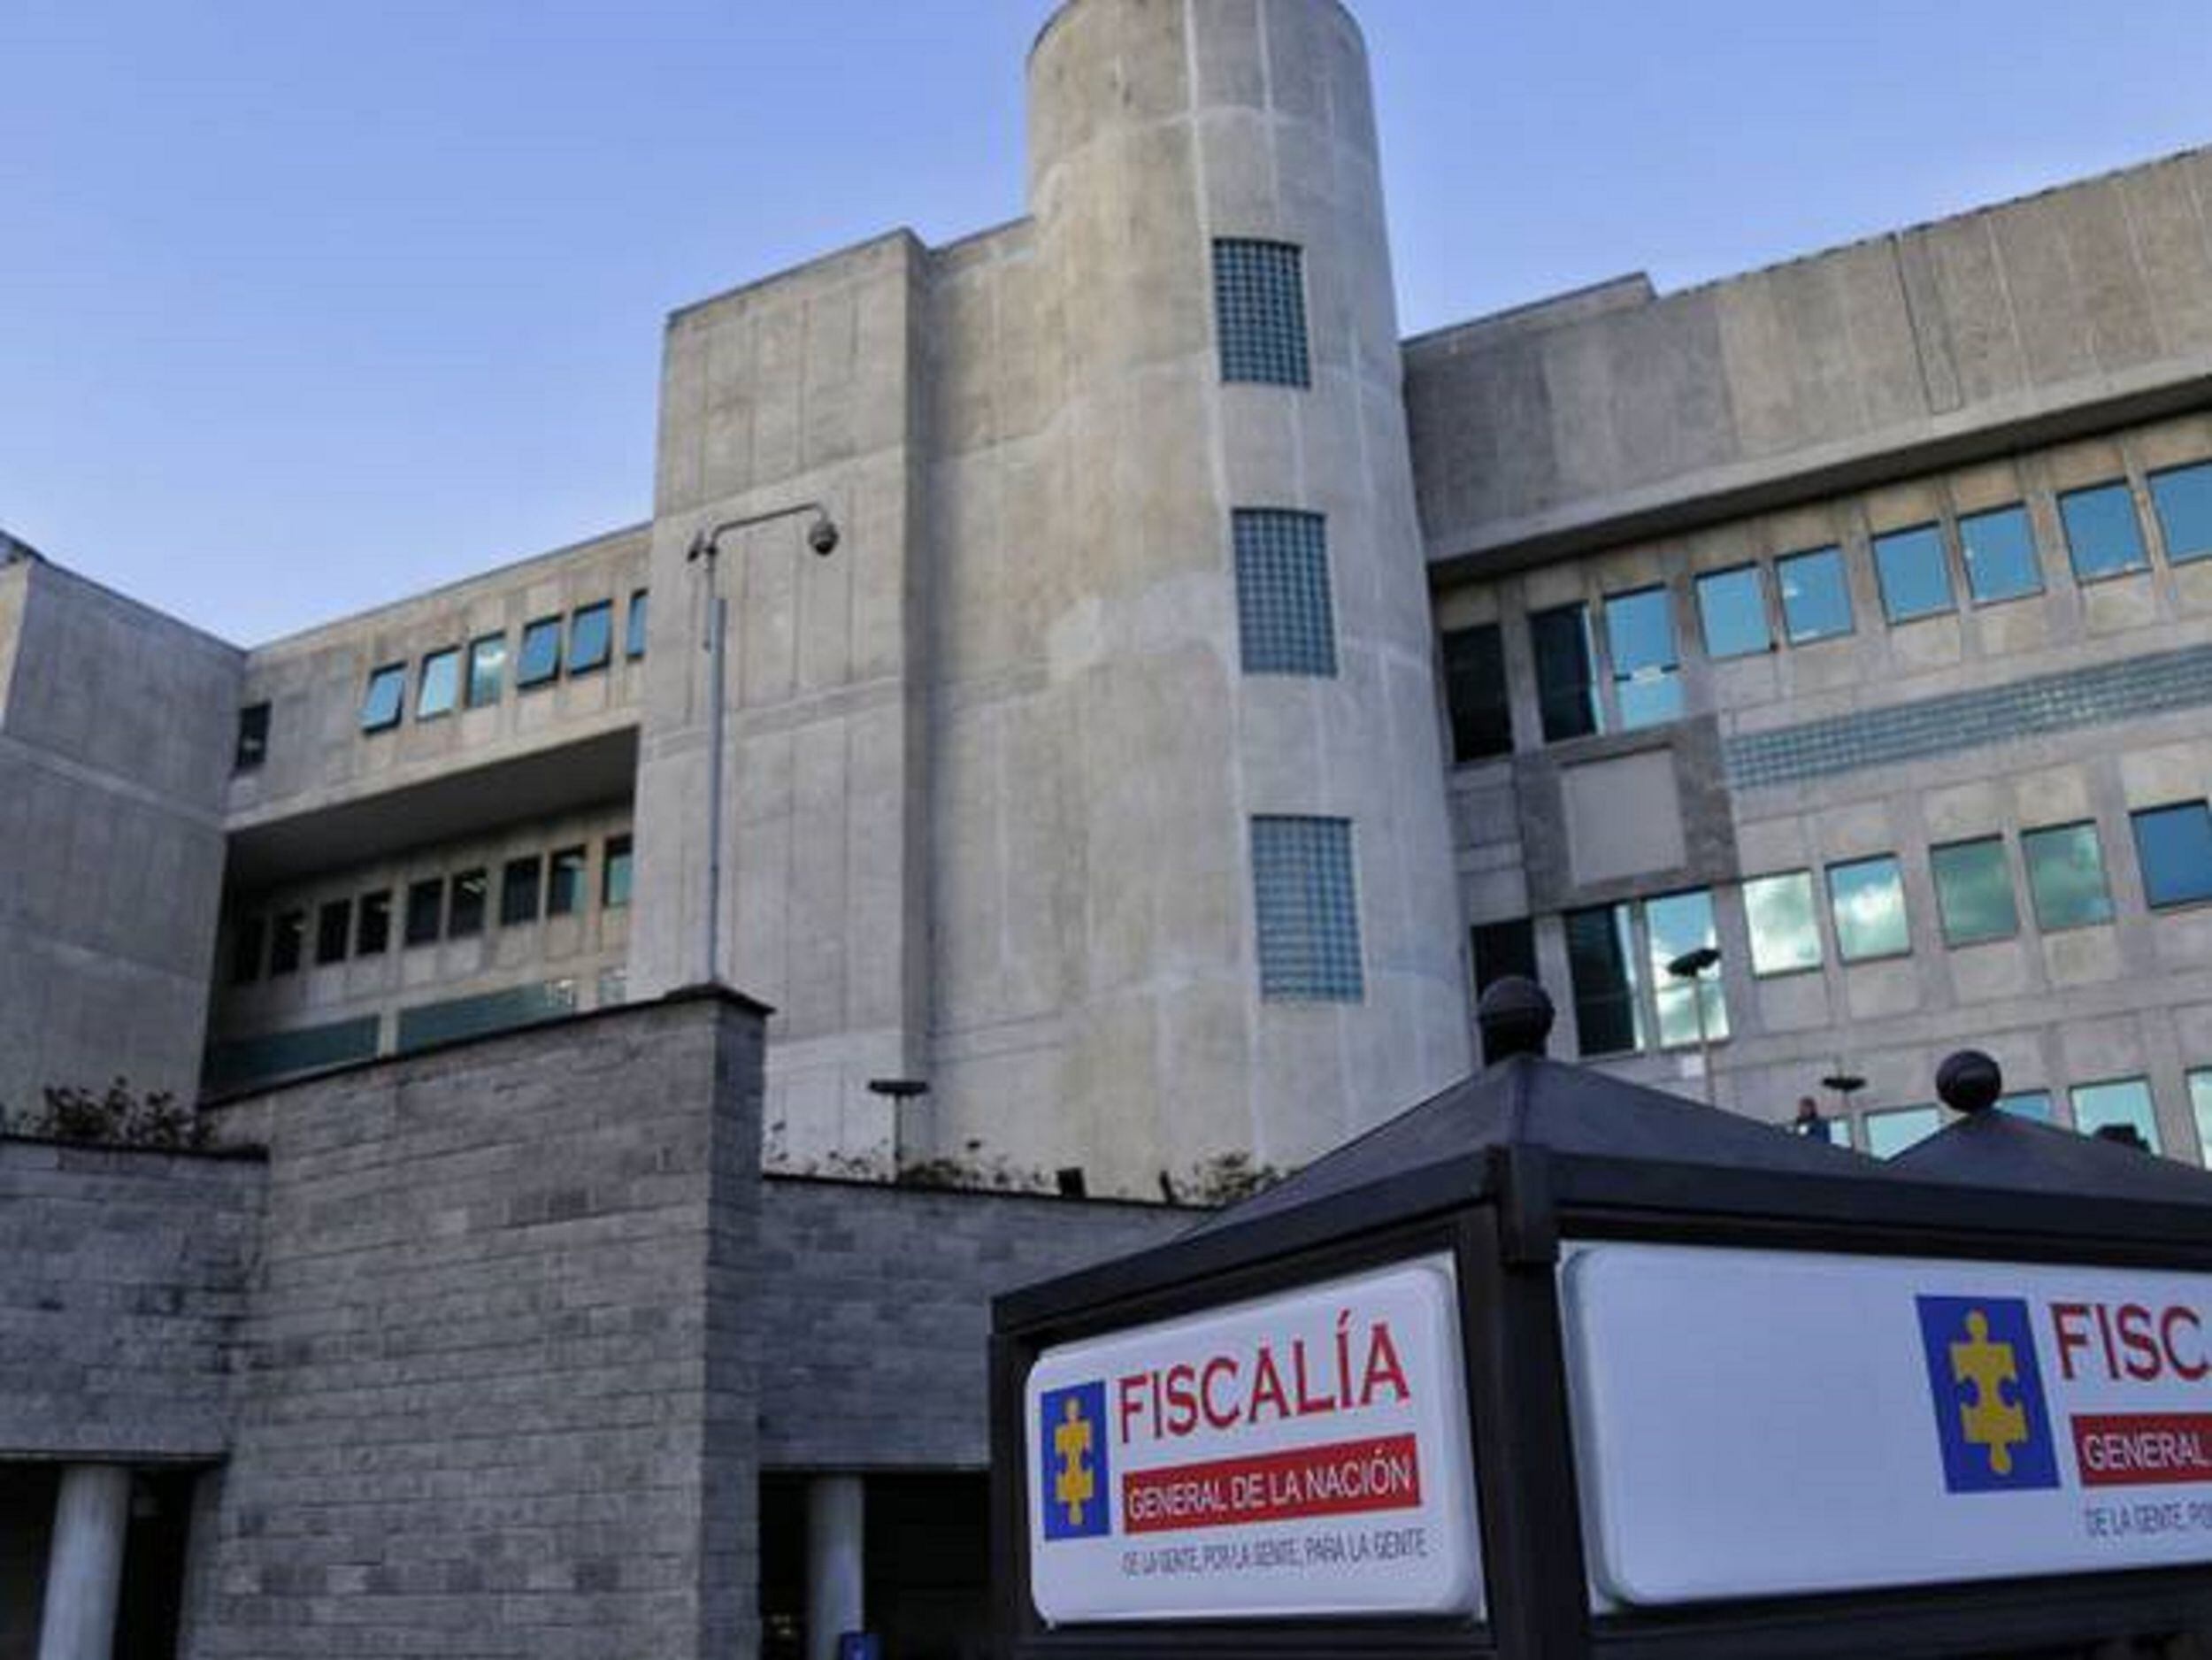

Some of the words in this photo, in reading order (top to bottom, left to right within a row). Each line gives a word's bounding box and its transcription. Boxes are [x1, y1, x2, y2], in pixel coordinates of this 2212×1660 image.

[1118, 1310, 1410, 1444] FISCALÍA
[2049, 1303, 2212, 1382] FISC
[1128, 1476, 1227, 1520] GENERAL
[1232, 1472, 1266, 1509] DE
[1270, 1469, 1302, 1503] LA
[1305, 1448, 1413, 1499] NACIÓN
[2082, 1431, 2212, 1471] GENERAL
[1305, 1533, 1346, 1564] PARA
[1347, 1531, 1370, 1563] LA
[1373, 1527, 1428, 1559] GENTE
